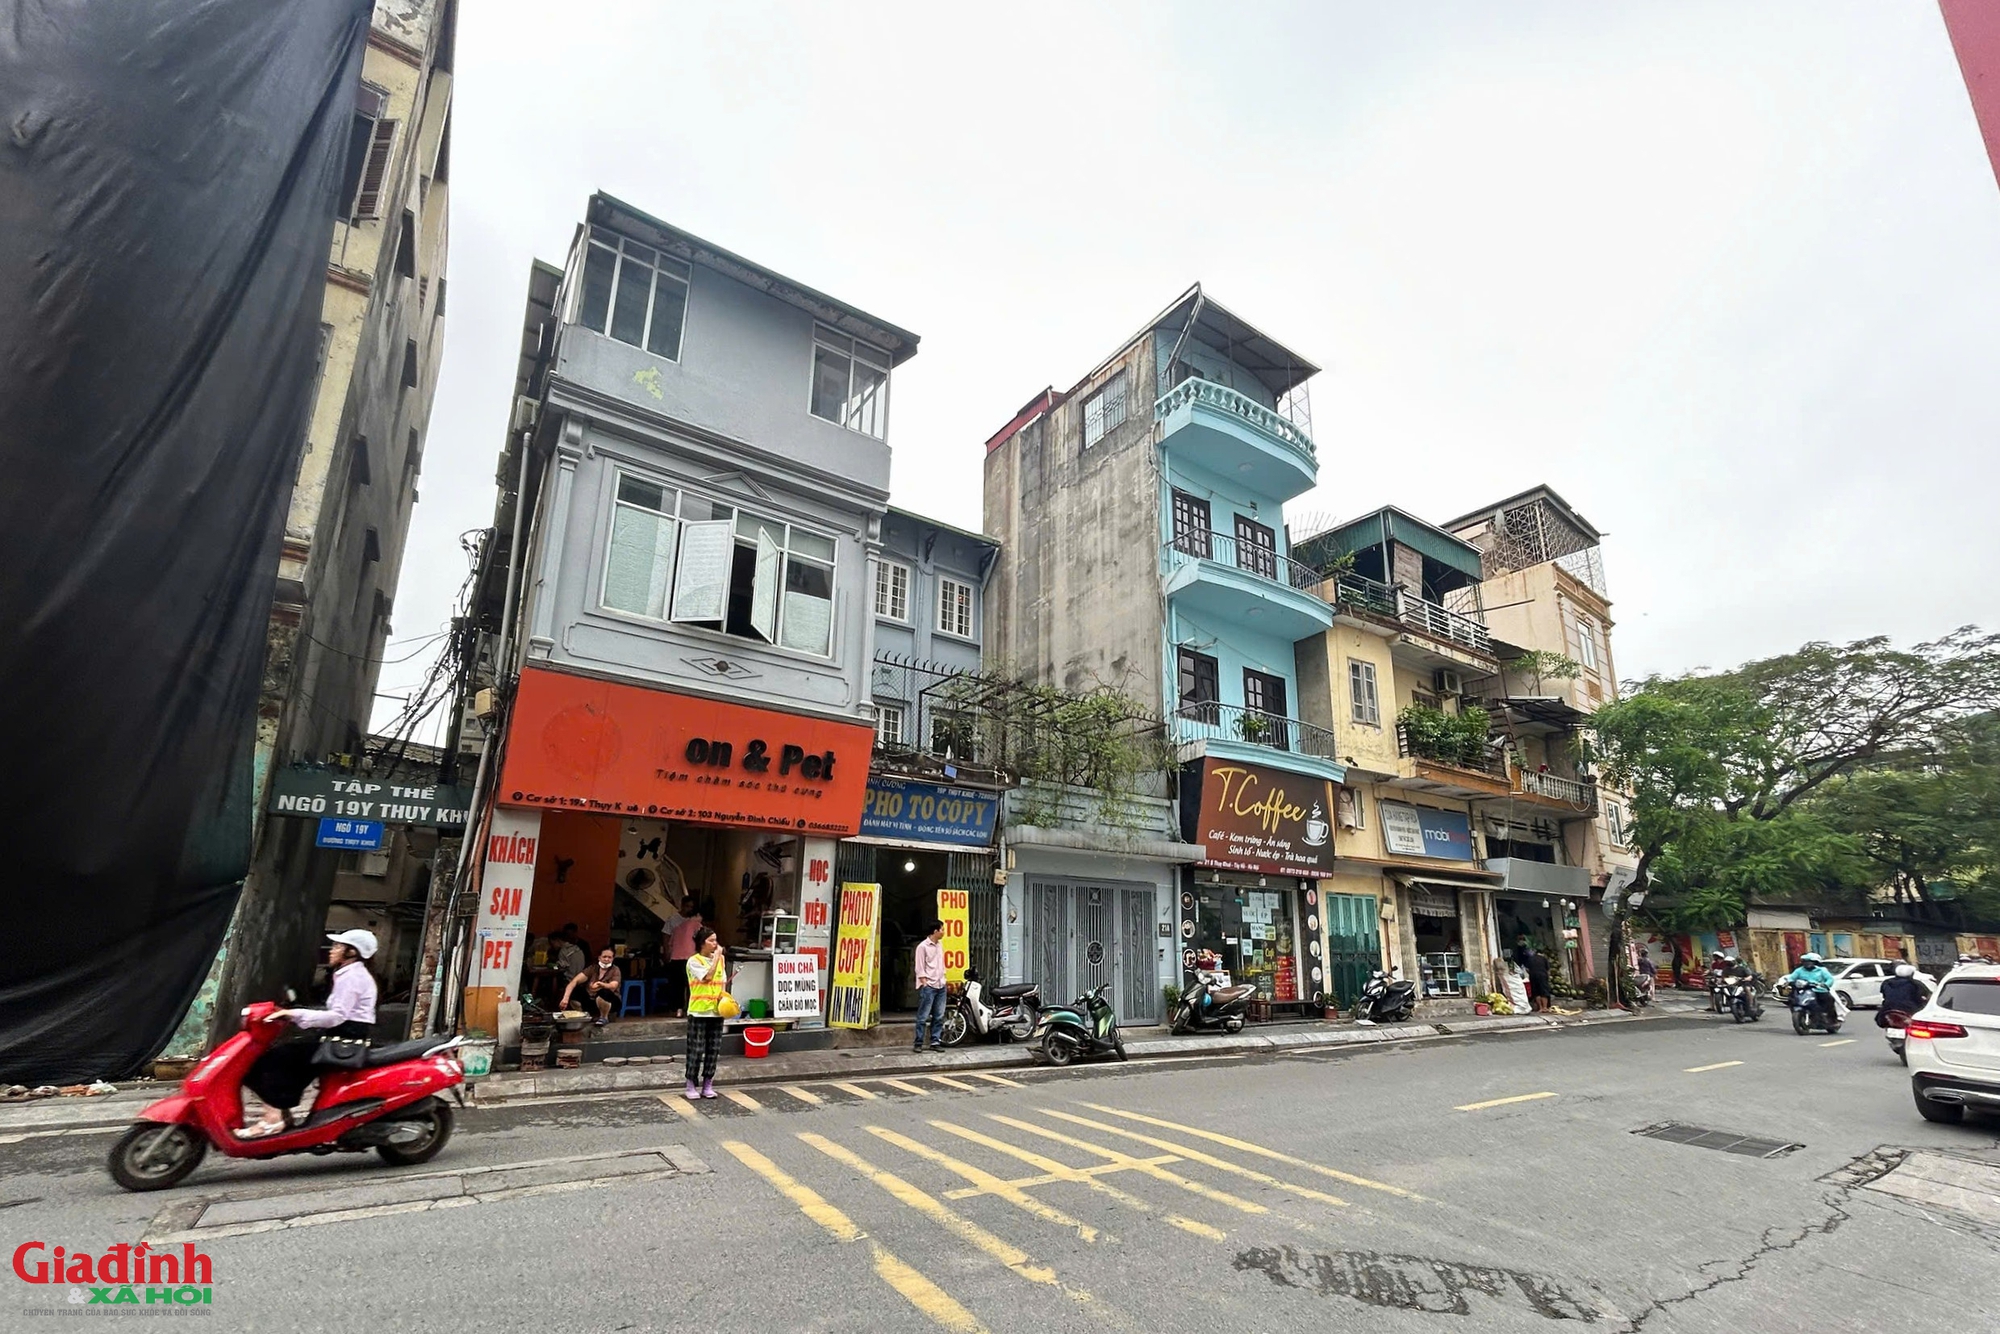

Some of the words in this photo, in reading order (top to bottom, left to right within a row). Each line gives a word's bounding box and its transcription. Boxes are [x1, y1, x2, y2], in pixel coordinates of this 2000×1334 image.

[743, 738, 771, 773] &
[780, 744, 836, 782] Pet
[331, 779, 381, 796] TẬP
[278, 794, 326, 813] NGÕ
[335, 800, 374, 817] 19Y
[379, 804, 431, 823] THỤY
[526, 793, 542, 802] Cơ
[589, 799, 613, 812] Thụy
[659, 806, 673, 815] Cơ
[714, 811, 746, 822] Nguyễn
[862, 788, 903, 818] PHO
[355, 824, 369, 834] 19Y
[488, 831, 537, 865] KHÁCH
[809, 859, 829, 886] HỌC
[490, 887, 523, 920] SẠN
[805, 898, 827, 929] VIỆN
[841, 890, 873, 927] PHOTO
[941, 891, 967, 909] PHO
[944, 919, 964, 937] TO
[482, 941, 512, 969] PET
[778, 960, 795, 974] BÚN
[797, 958, 814, 974] CHẢ
[838, 937, 868, 974] COPY
[944, 950, 965, 969] CO
[778, 980, 793, 995] DỌC
[794, 978, 816, 992] MÙNG
[832, 986, 843, 1022] IN
